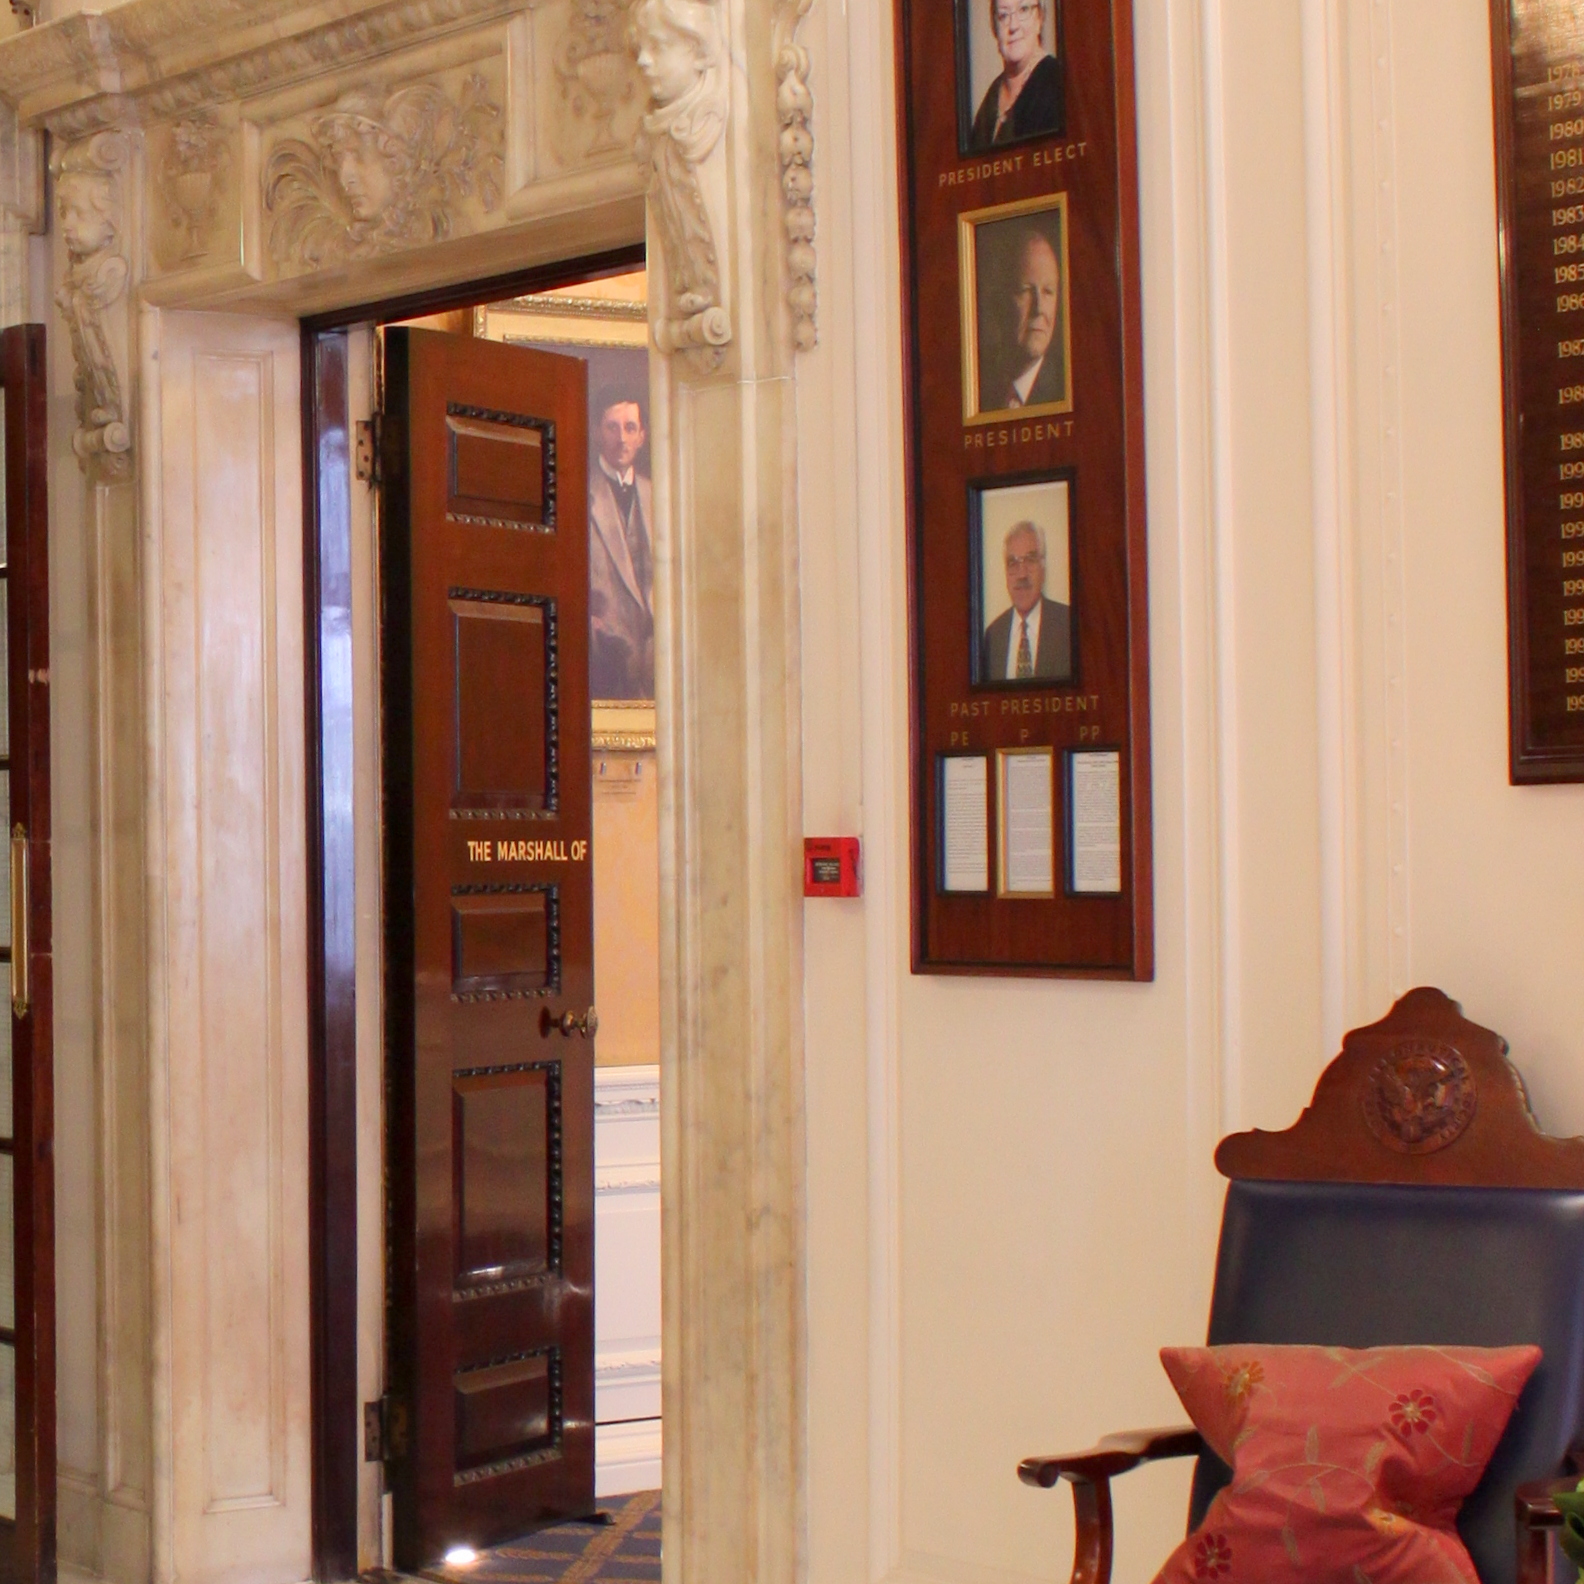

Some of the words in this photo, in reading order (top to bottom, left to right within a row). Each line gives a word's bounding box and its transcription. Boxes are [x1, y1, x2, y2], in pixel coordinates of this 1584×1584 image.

[1549, 118, 1584, 141] 1980
[938, 156, 1024, 187] PRESIDENT
[1033, 142, 1087, 166] ELECT
[1550, 147, 1584, 170] 1981
[1551, 176, 1584, 198] 1982
[1552, 205, 1584, 227] 1983
[1558, 385, 1584, 404] 198
[964, 420, 1074, 449] PRESIDENT
[1560, 432, 1584, 451] 198
[950, 701, 990, 716] PAST
[1001, 695, 1099, 715] PRESIDENT
[950, 731, 969, 746] PE
[1020, 728, 1030, 742] P
[1079, 725, 1100, 741] PP
[467, 840, 492, 862] THE
[497, 840, 568, 862] MARSHALL
[571, 840, 588, 862] OF
